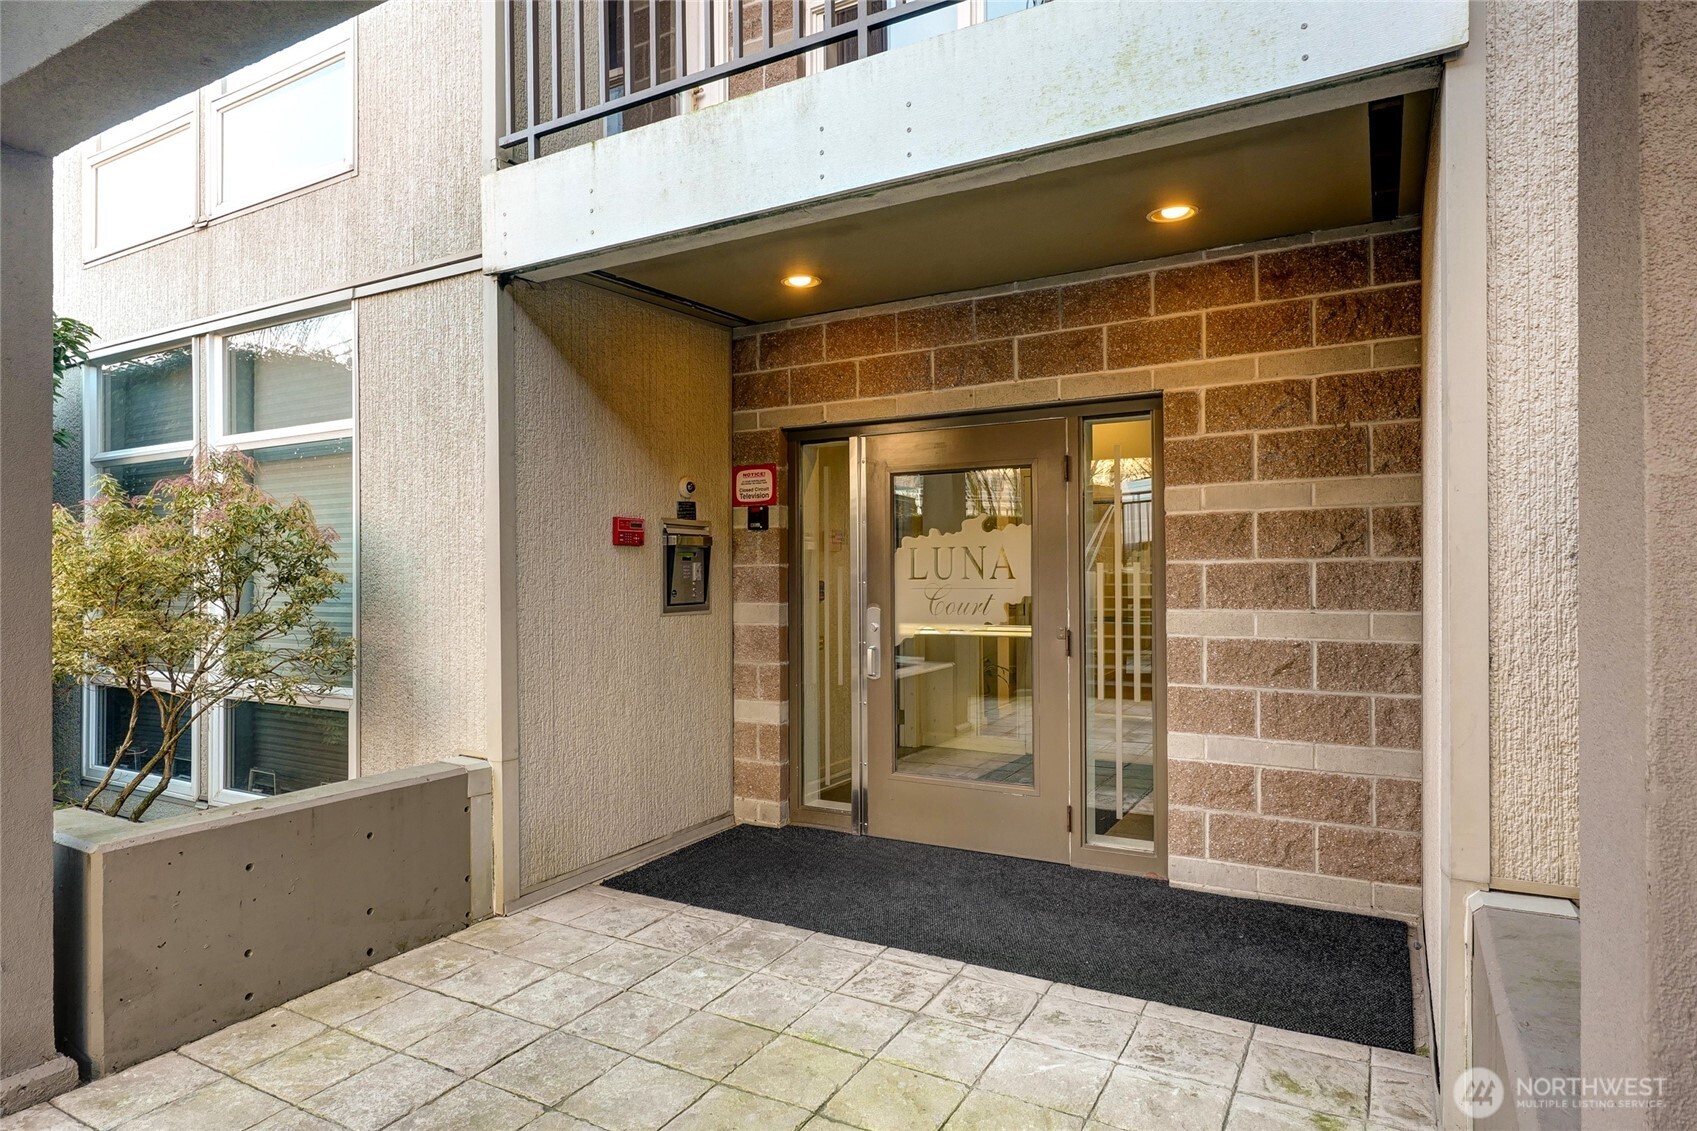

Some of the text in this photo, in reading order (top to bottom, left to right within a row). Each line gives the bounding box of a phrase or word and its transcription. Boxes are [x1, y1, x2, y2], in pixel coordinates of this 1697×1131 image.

[739, 492, 770, 500] Television
[908, 545, 1016, 580] LUNA
[924, 583, 996, 616] Court
